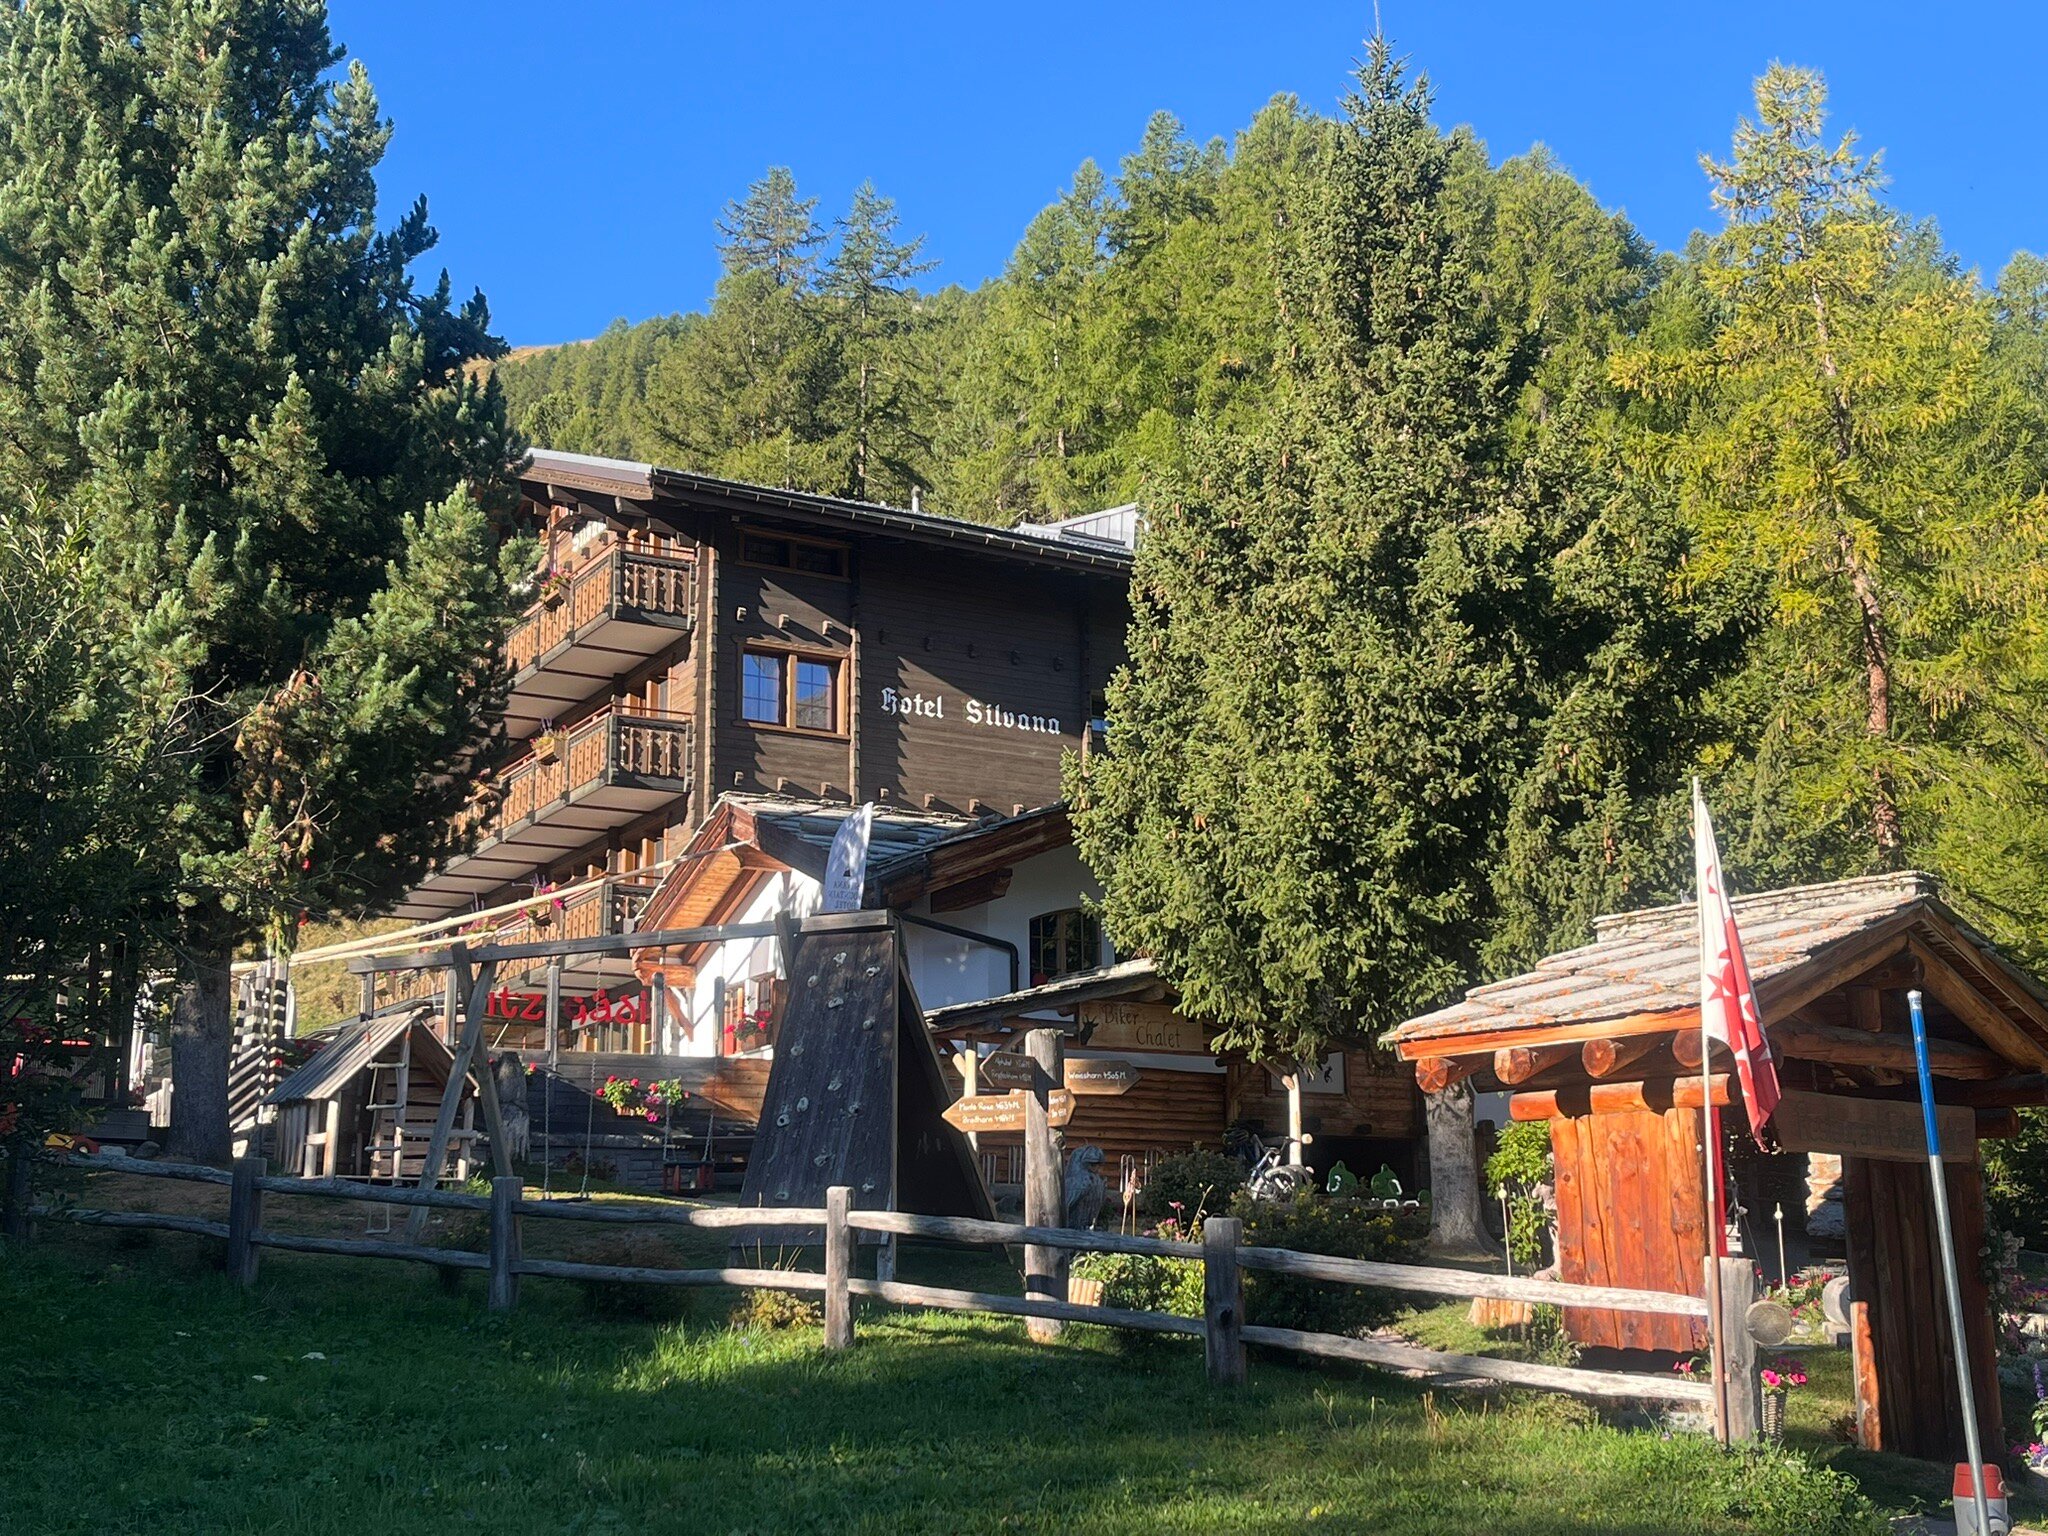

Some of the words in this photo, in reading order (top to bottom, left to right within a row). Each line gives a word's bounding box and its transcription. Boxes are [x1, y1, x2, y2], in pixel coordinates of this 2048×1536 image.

[880, 686, 945, 719] Hotel
[966, 699, 1061, 735] Silvana
[488, 986, 545, 1020] itz
[1102, 1003, 1140, 1025] Biker
[1136, 1021, 1180, 1048] Chalet
